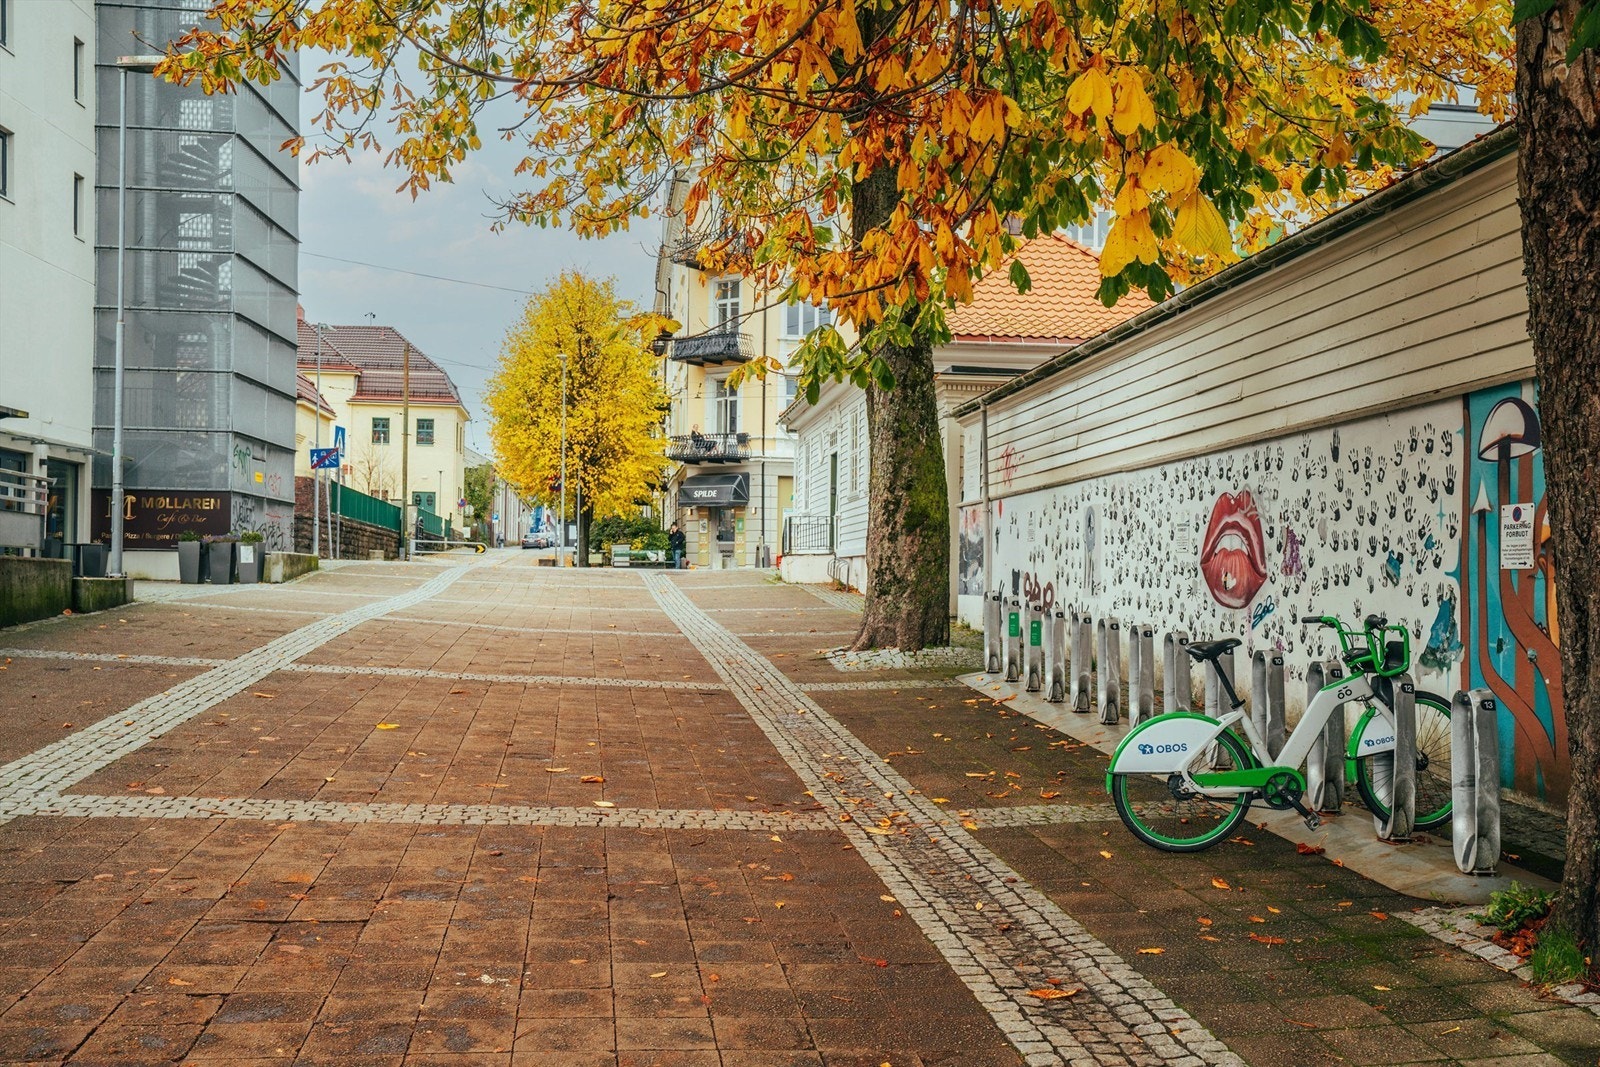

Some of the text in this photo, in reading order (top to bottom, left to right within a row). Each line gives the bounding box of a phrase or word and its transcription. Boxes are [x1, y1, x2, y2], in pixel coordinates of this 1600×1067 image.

[693, 490, 717, 498] SPILDE
[141, 497, 220, 510] MØLLAREN
[1484, 701, 1494, 709] 13
[1375, 736, 1395, 745] OBOS
[1156, 743, 1188, 753] OBOS
